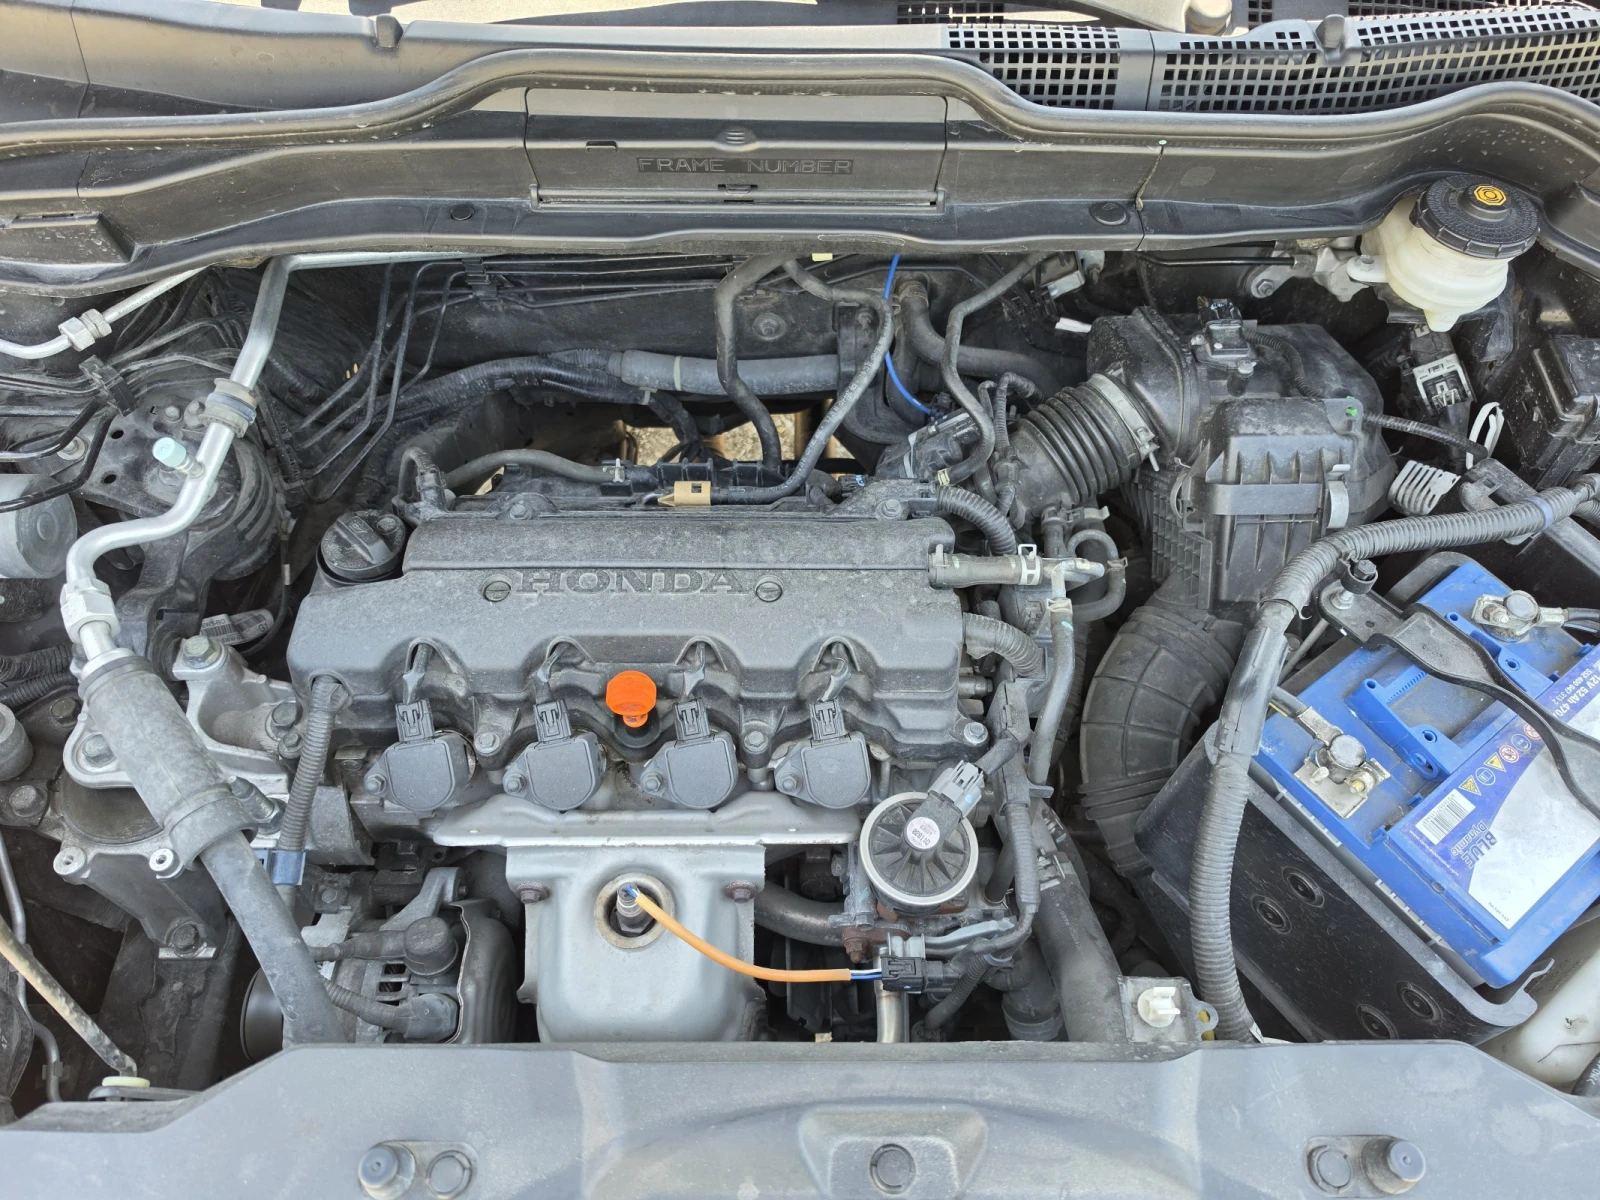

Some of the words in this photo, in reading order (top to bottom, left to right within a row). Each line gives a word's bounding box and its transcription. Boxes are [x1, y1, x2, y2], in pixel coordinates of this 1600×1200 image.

[638, 158, 726, 173] FRAME
[747, 160, 852, 175] NUMBER
[516, 568, 750, 595] HONDA
[1451, 820, 1488, 858] Dynamic
[1461, 830, 1498, 868] BLUE
